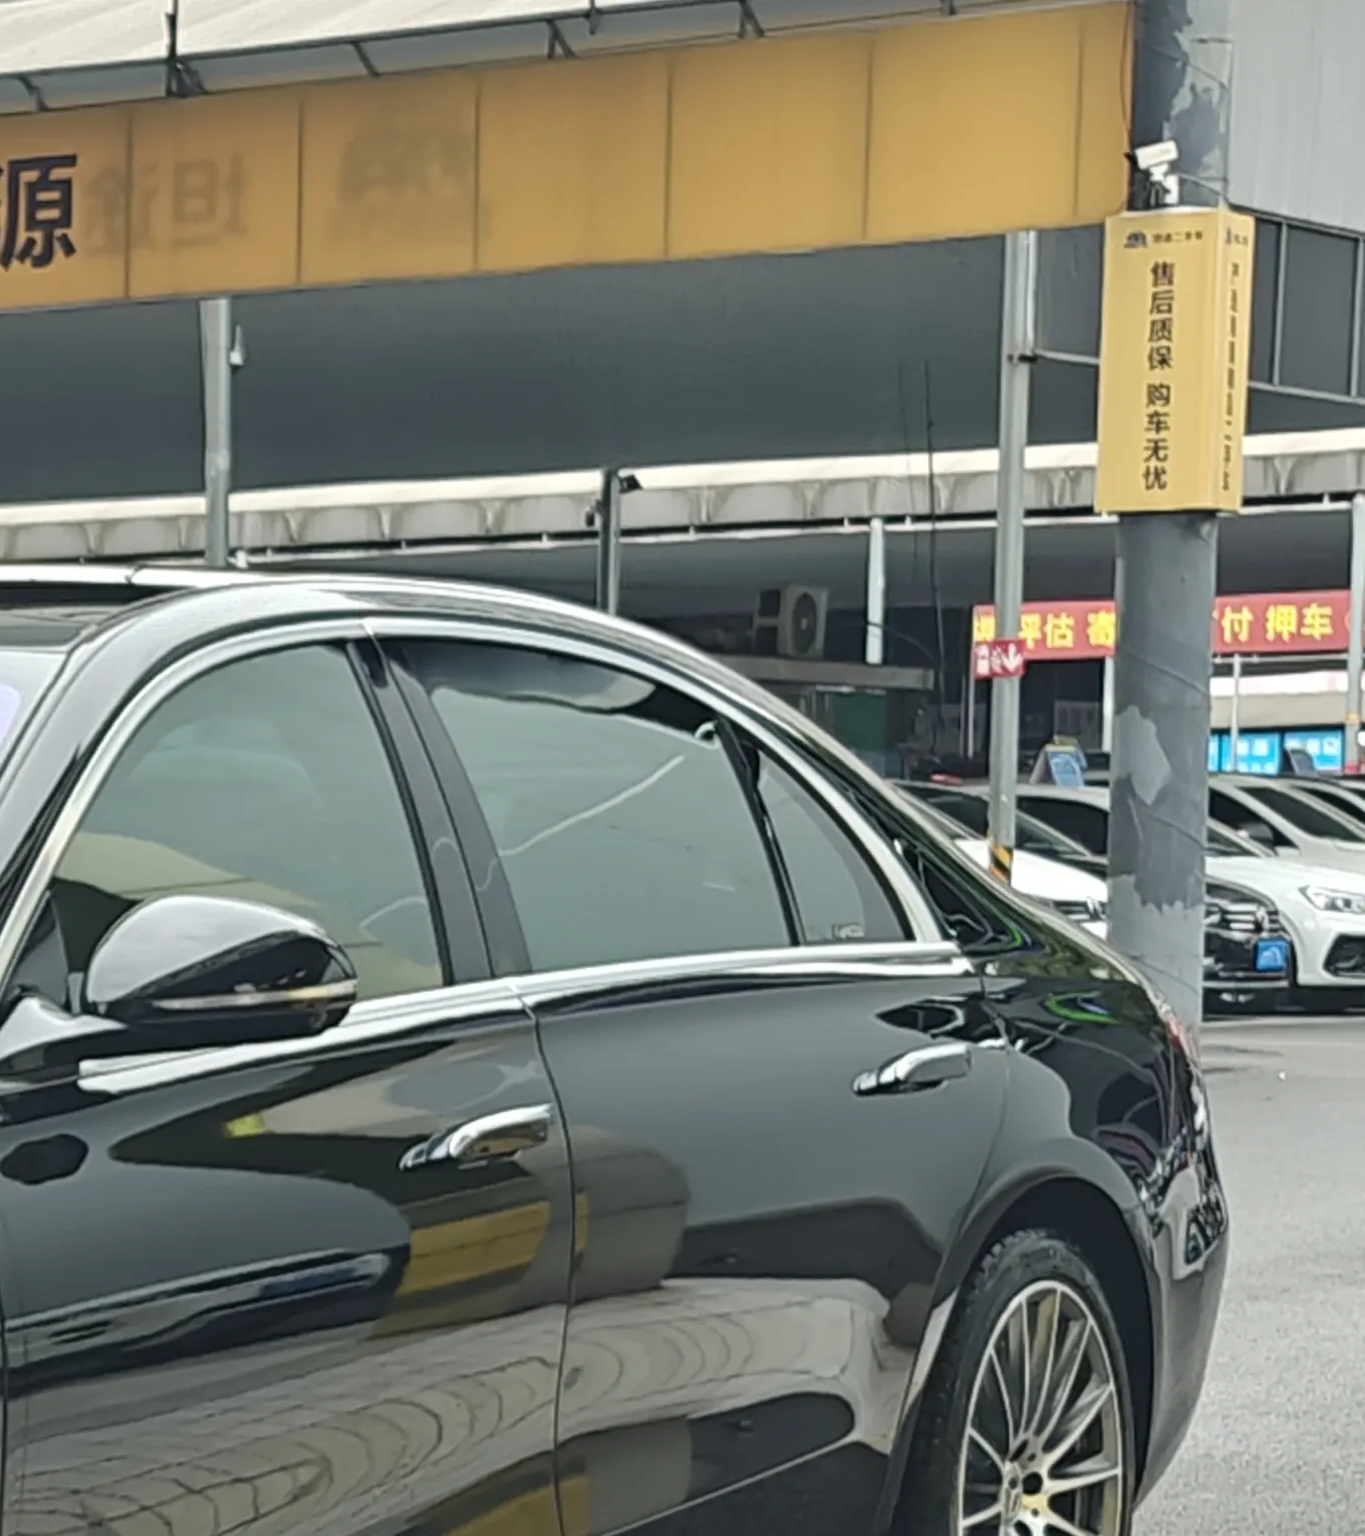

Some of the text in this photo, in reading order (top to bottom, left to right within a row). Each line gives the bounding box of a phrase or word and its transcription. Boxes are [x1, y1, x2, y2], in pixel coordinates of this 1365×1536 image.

[1141, 260, 1176, 491] 售后质保 购车无忧
[1265, 602, 1335, 643] 押车
